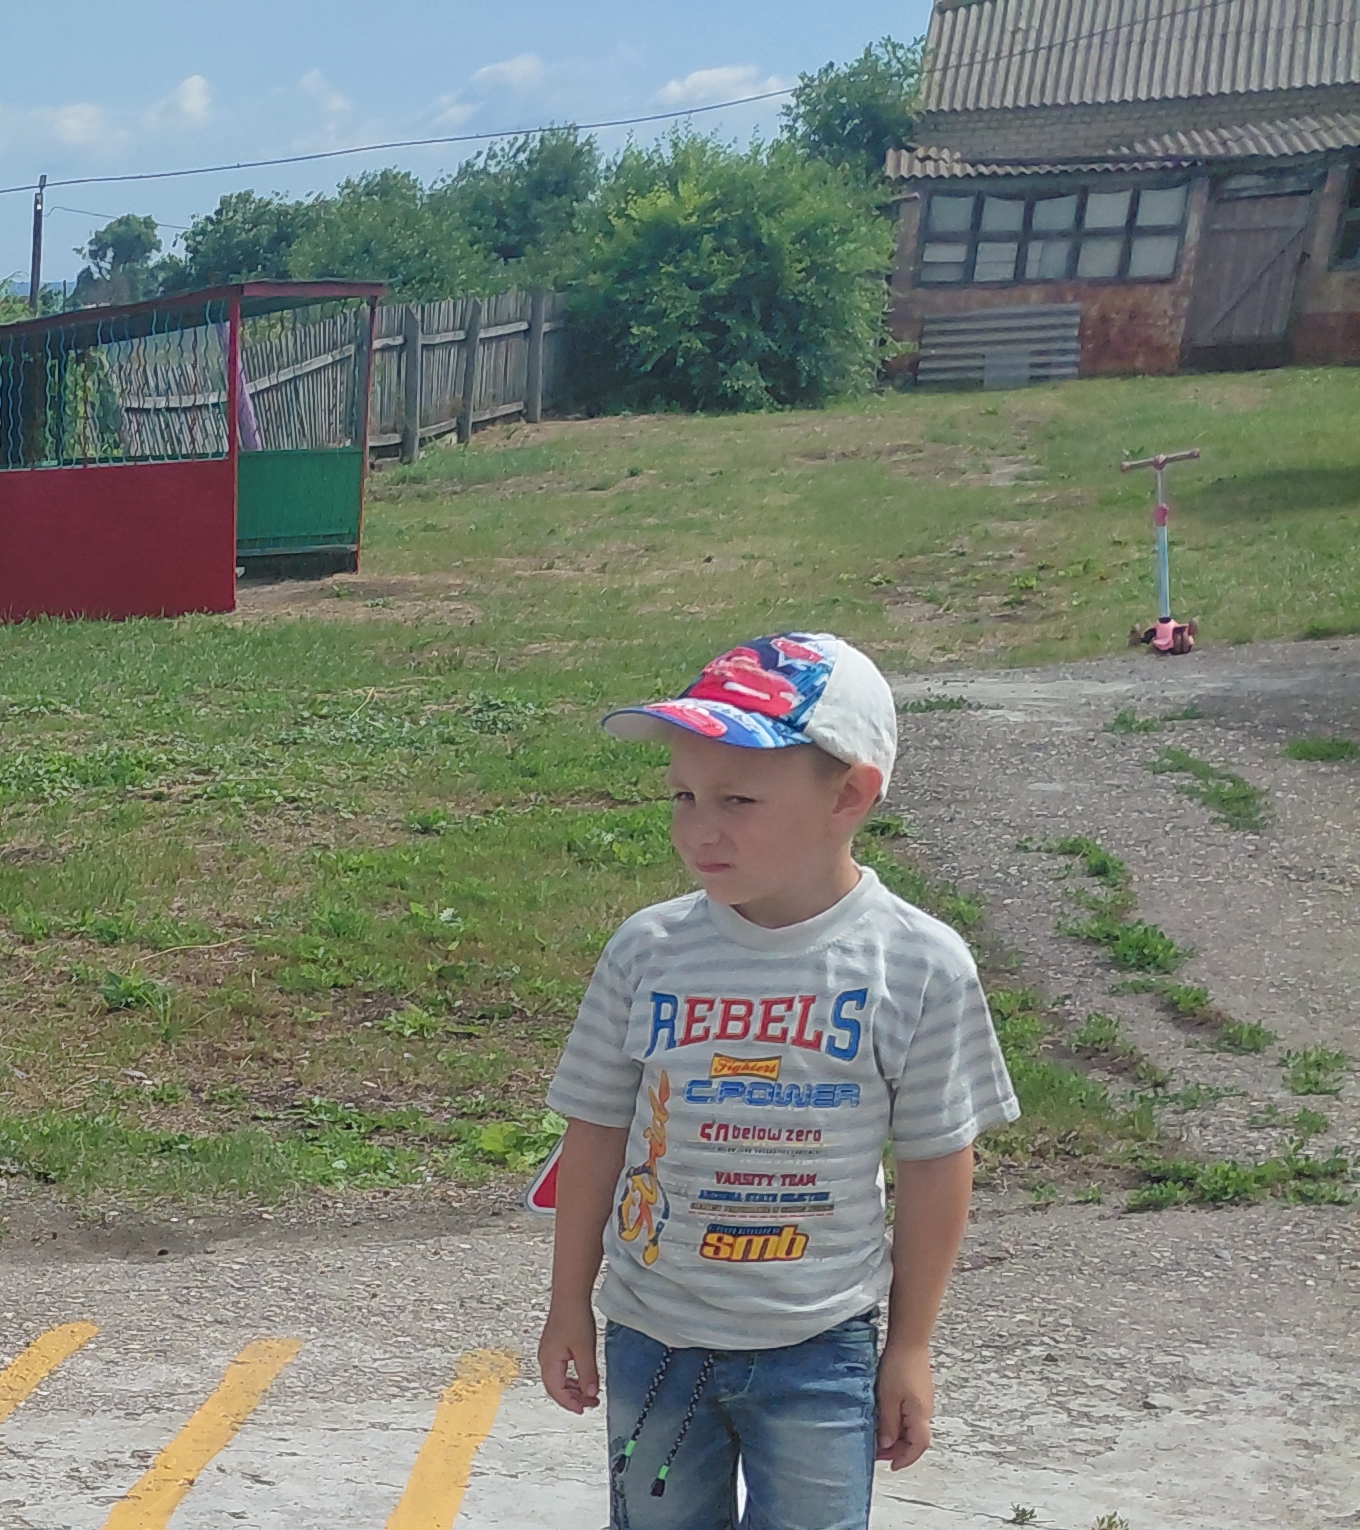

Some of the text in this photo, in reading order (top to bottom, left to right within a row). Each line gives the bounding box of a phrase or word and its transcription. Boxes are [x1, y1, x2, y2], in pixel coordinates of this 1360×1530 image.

[643, 987, 869, 1062] REBELS
[732, 1125, 782, 1141] below
[785, 1128, 822, 1143] zero
[780, 1172, 818, 1187] TEAM
[701, 1225, 809, 1261] smb
